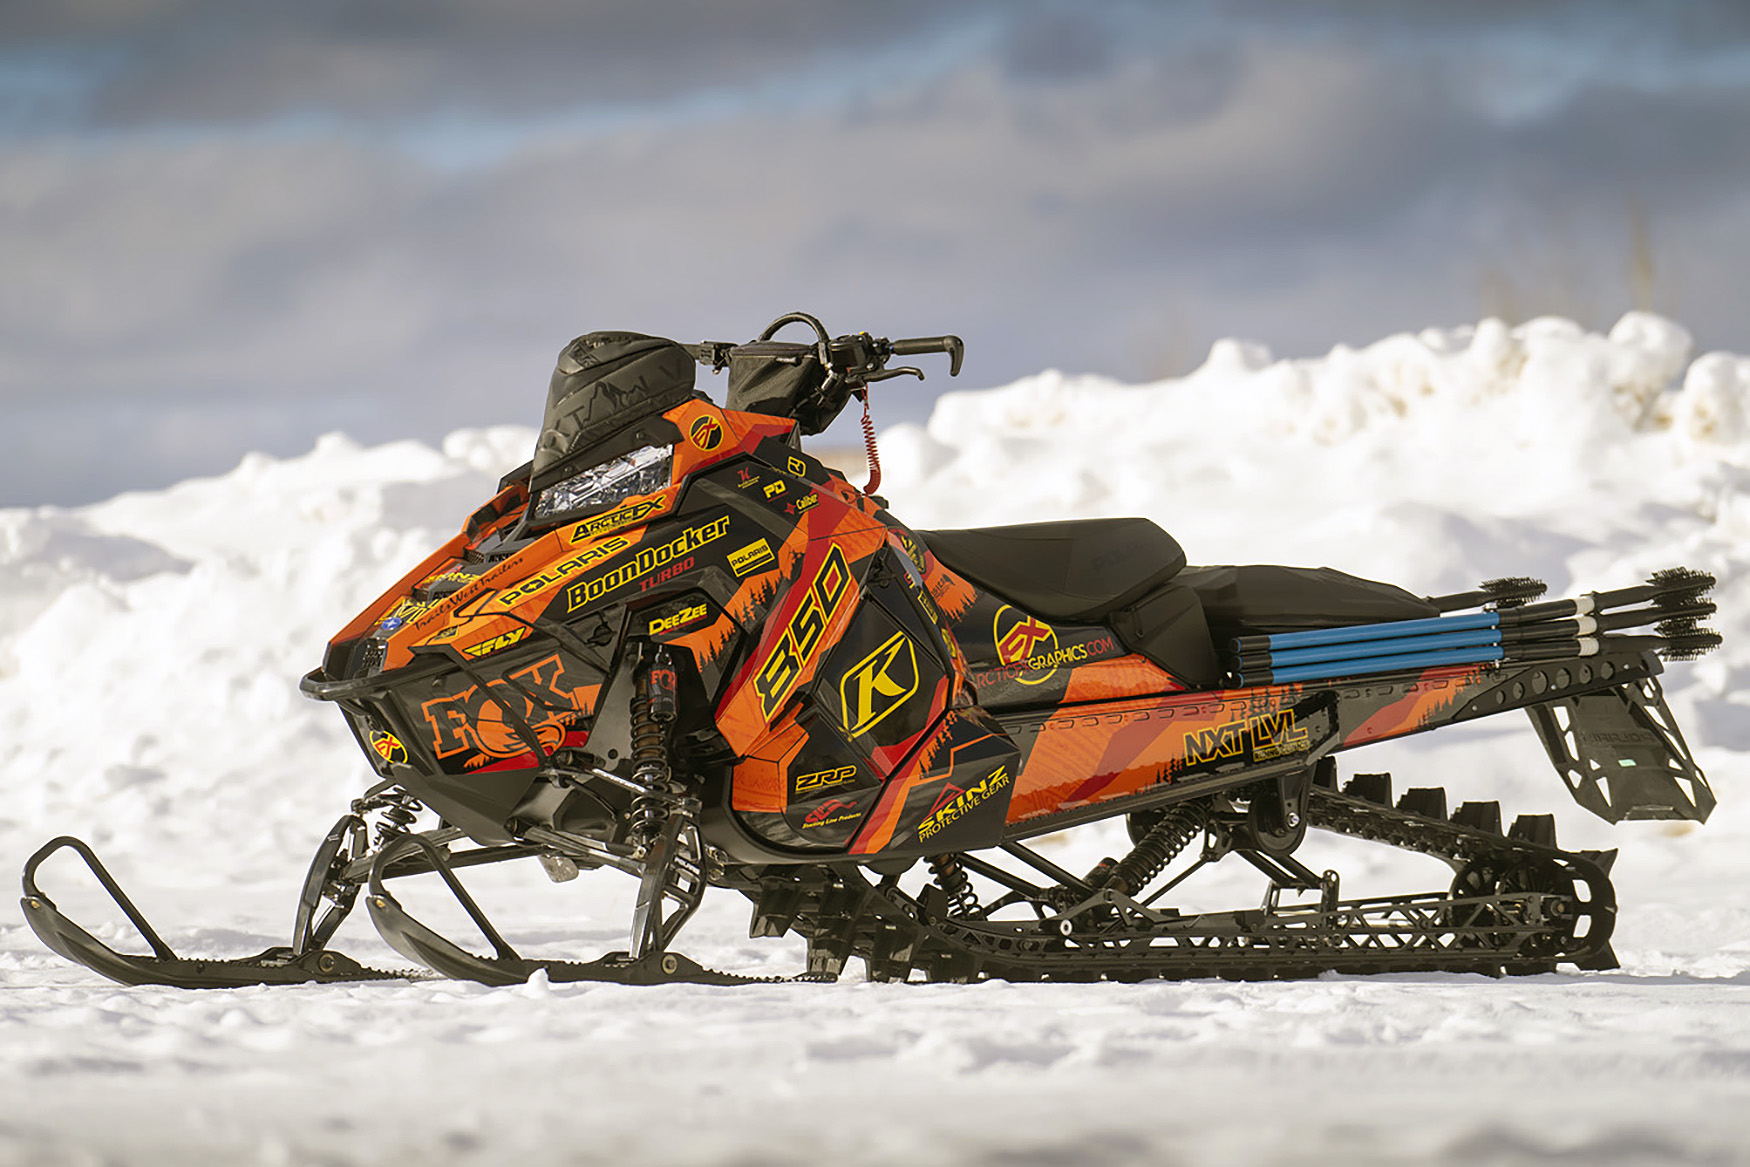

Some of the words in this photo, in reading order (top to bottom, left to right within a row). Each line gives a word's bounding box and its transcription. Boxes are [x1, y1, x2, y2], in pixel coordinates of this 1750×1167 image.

[496, 536, 630, 607] POLARIS
[567, 515, 730, 613] BoonDocker
[639, 556, 695, 592] TURBO
[753, 542, 852, 723] 850
[1183, 719, 1247, 766] NXT
[1249, 708, 1308, 751] LVL
[796, 765, 857, 791] ZRP
[918, 765, 1008, 834] SKINZ
[919, 795, 981, 843] PROTECTIVE
[981, 776, 1010, 800] GEAR
